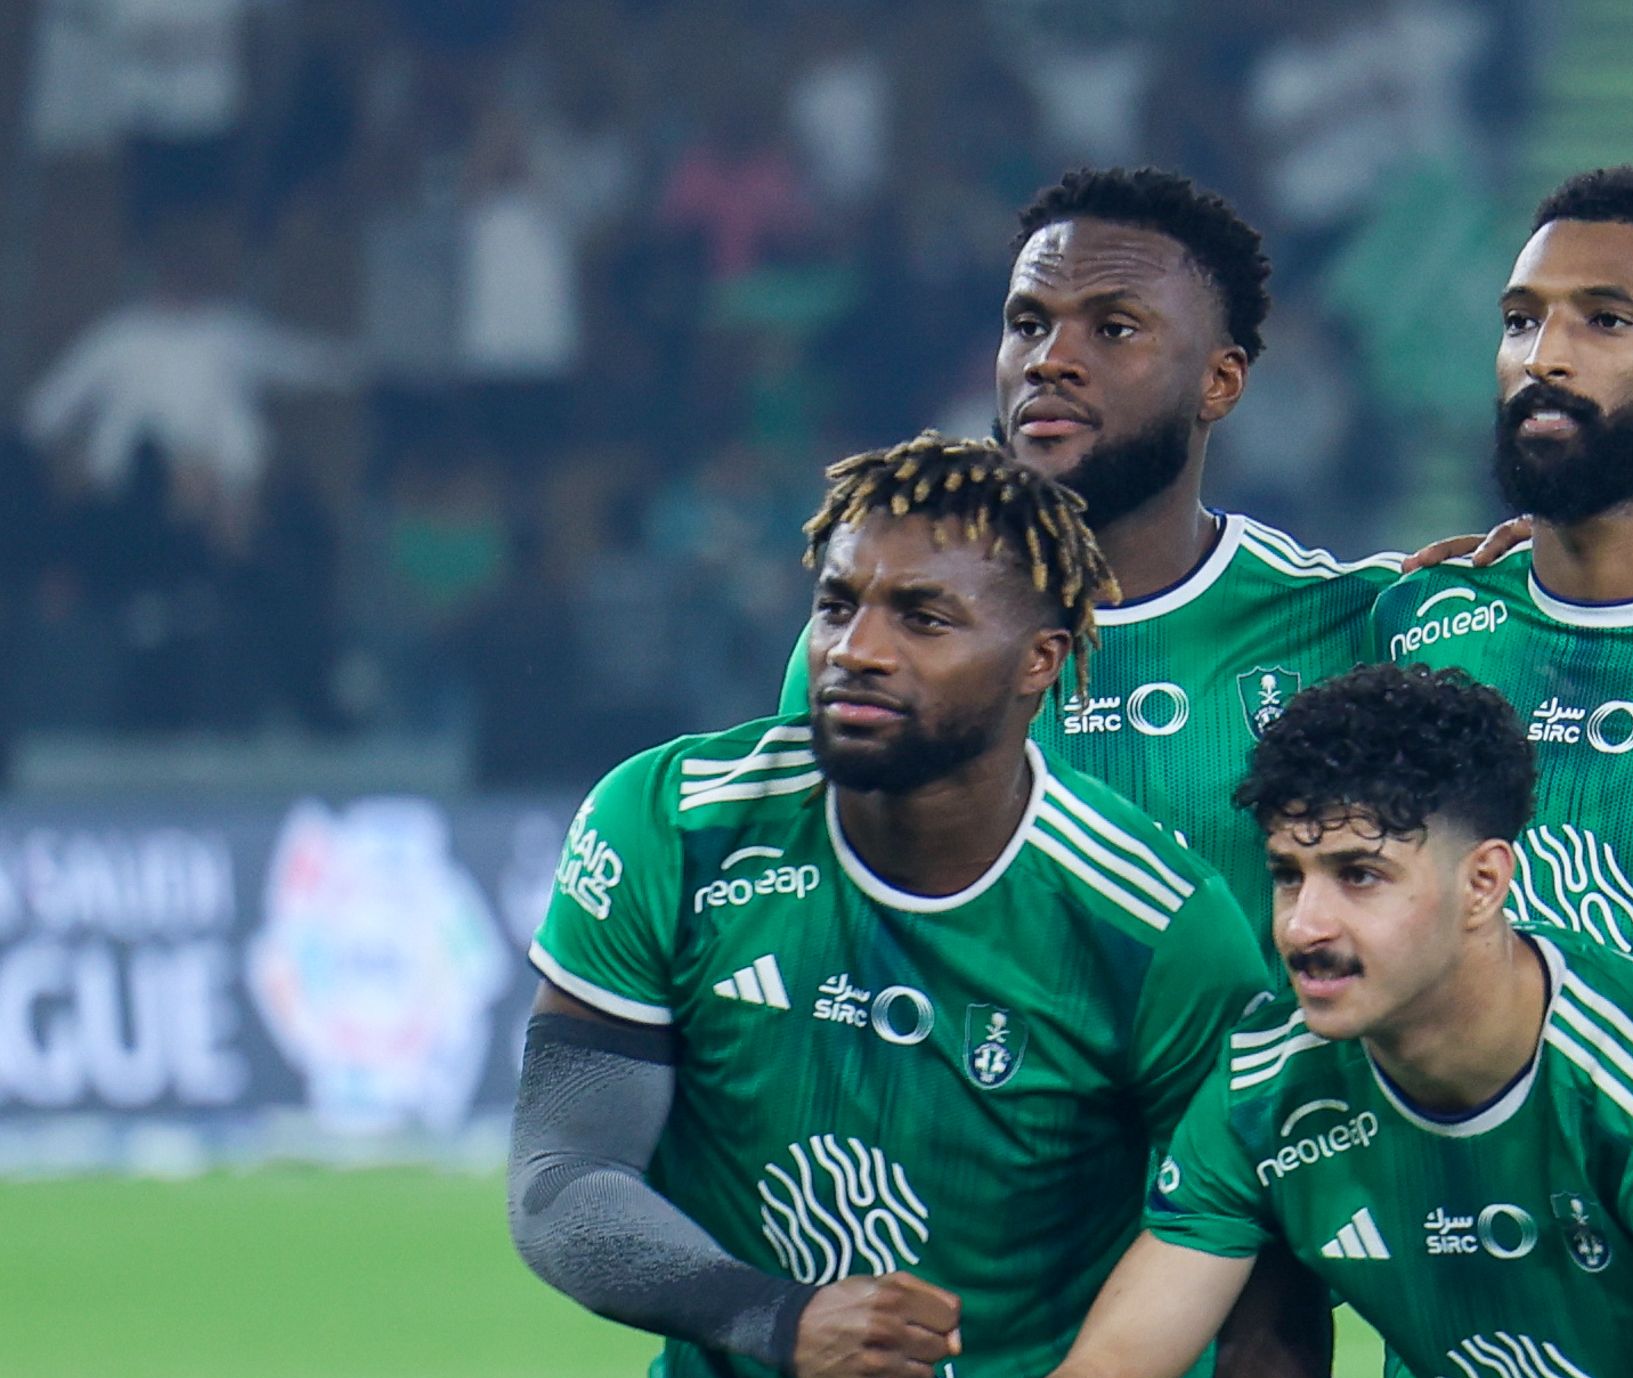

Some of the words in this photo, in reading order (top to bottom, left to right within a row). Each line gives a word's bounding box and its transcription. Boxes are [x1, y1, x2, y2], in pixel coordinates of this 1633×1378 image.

[1391, 599, 1508, 661] neoleap
[1063, 714, 1122, 735] SIRC
[1527, 723, 1581, 745] SIRC
[813, 999, 868, 1028] SIRC
[1426, 1234, 1478, 1256] SIRC
